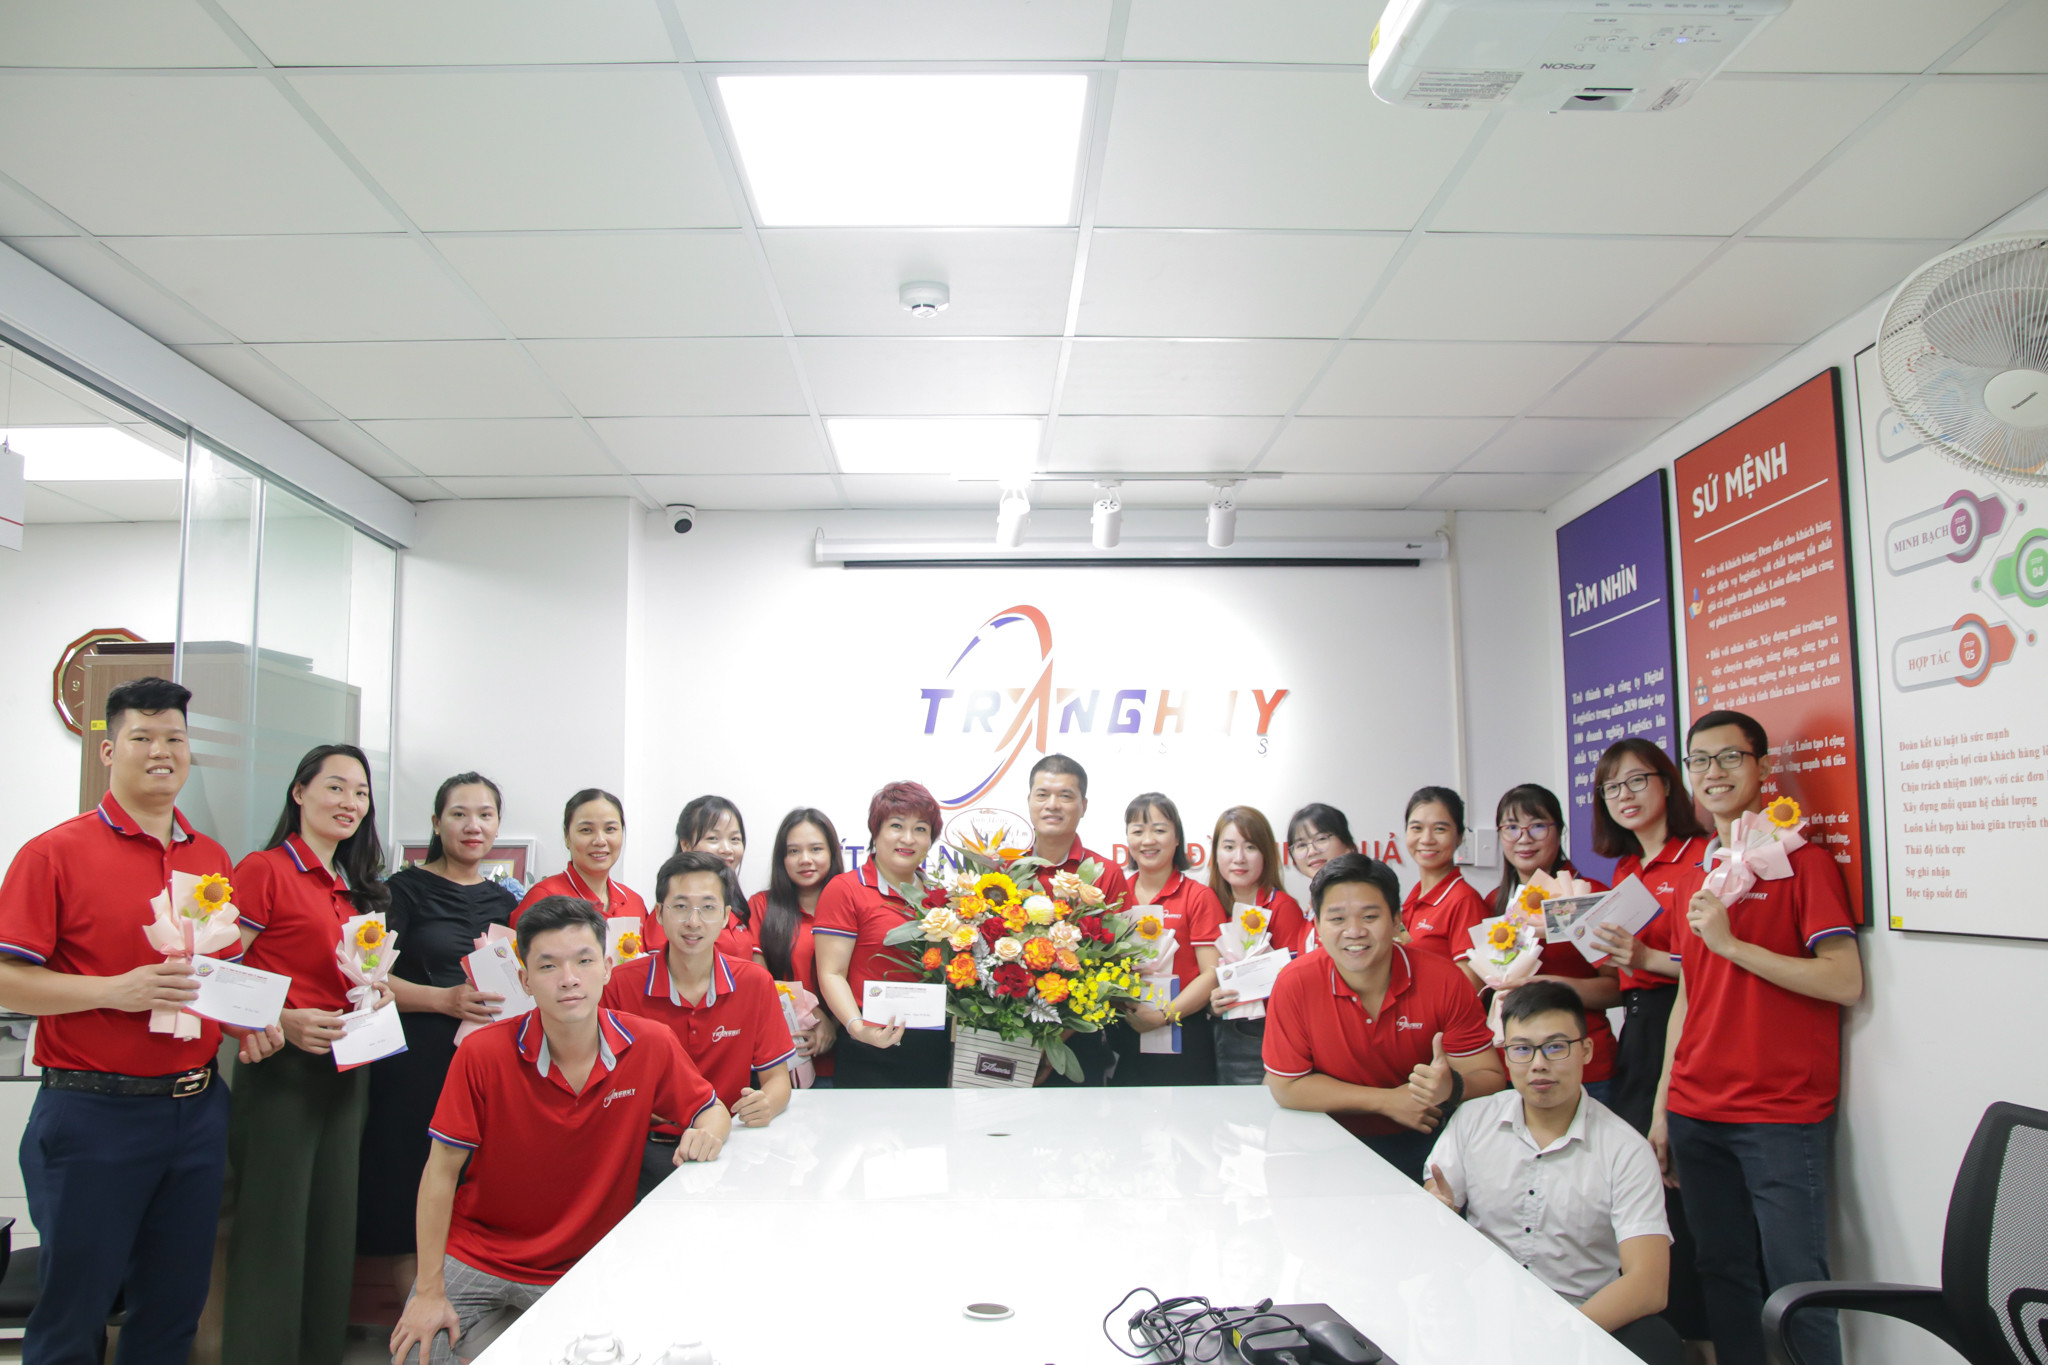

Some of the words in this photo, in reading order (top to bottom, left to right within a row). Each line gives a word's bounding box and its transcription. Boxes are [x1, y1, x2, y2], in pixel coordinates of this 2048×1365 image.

[1692, 474, 1719, 519] SỨ
[1724, 442, 1788, 503] MỆNH
[1893, 535, 1919, 553] MINH
[1922, 525, 1949, 545] BẠCH
[1956, 525, 1967, 536] 03
[2032, 566, 2045, 578] 04
[1568, 582, 1597, 617] TẦM
[1600, 563, 1637, 605] NHÌN
[1816, 658, 1828, 669] cao
[1908, 655, 1928, 671] HỢP
[1932, 649, 1951, 666] TÁC
[1964, 649, 1976, 661] 05
[1643, 667, 1664, 687] Digital
[1572, 709, 1596, 726] Logistics
[1627, 717, 1653, 735] Logistics
[1899, 741, 1918, 751] Đoàn
[1920, 735, 1932, 748] kết
[1943, 735, 1959, 747] luật
[1961, 733, 1968, 743] là
[1970, 731, 1983, 742] sức
[1986, 728, 2010, 742] mạnh
[1900, 761, 1919, 771] Luôn
[1921, 759, 1934, 770] đặt
[1935, 753, 1959, 770] quyền
[1990, 749, 2016, 762] khách
[2018, 747, 2040, 760] hàng
[1901, 782, 1919, 794] Chịu
[1921, 779, 1941, 790] trách
[1943, 777, 1967, 791] nhiệm
[1969, 775, 1992, 787] 100%
[1994, 774, 2008, 785] với
[2010, 772, 2024, 783] các
[2027, 771, 2044, 782] đơn
[1903, 801, 1917, 814] Xây
[1919, 801, 1939, 813] dựng
[1957, 800, 1977, 812] quan
[1979, 796, 1989, 809] hệ
[1991, 792, 2009, 807] chất
[2011, 795, 2038, 808] lượng
[1904, 822, 1923, 833] Luôn
[1925, 819, 1937, 832] kết
[1939, 822, 1954, 834] hợp
[1970, 820, 1985, 830] hoà
[2008, 814, 2037, 831] truyền
[1905, 845, 1922, 855] Thái
[1924, 844, 1933, 856] độ
[1952, 845, 1965, 856] cực
[1905, 866, 1916, 878] Sự
[1917, 866, 1929, 878] ghi
[1931, 866, 1950, 879] nhận
[1906, 887, 1920, 899] Học
[1922, 888, 1935, 900] tập
[1936, 885, 1953, 898] suốt
[1954, 889, 1968, 899] đời
